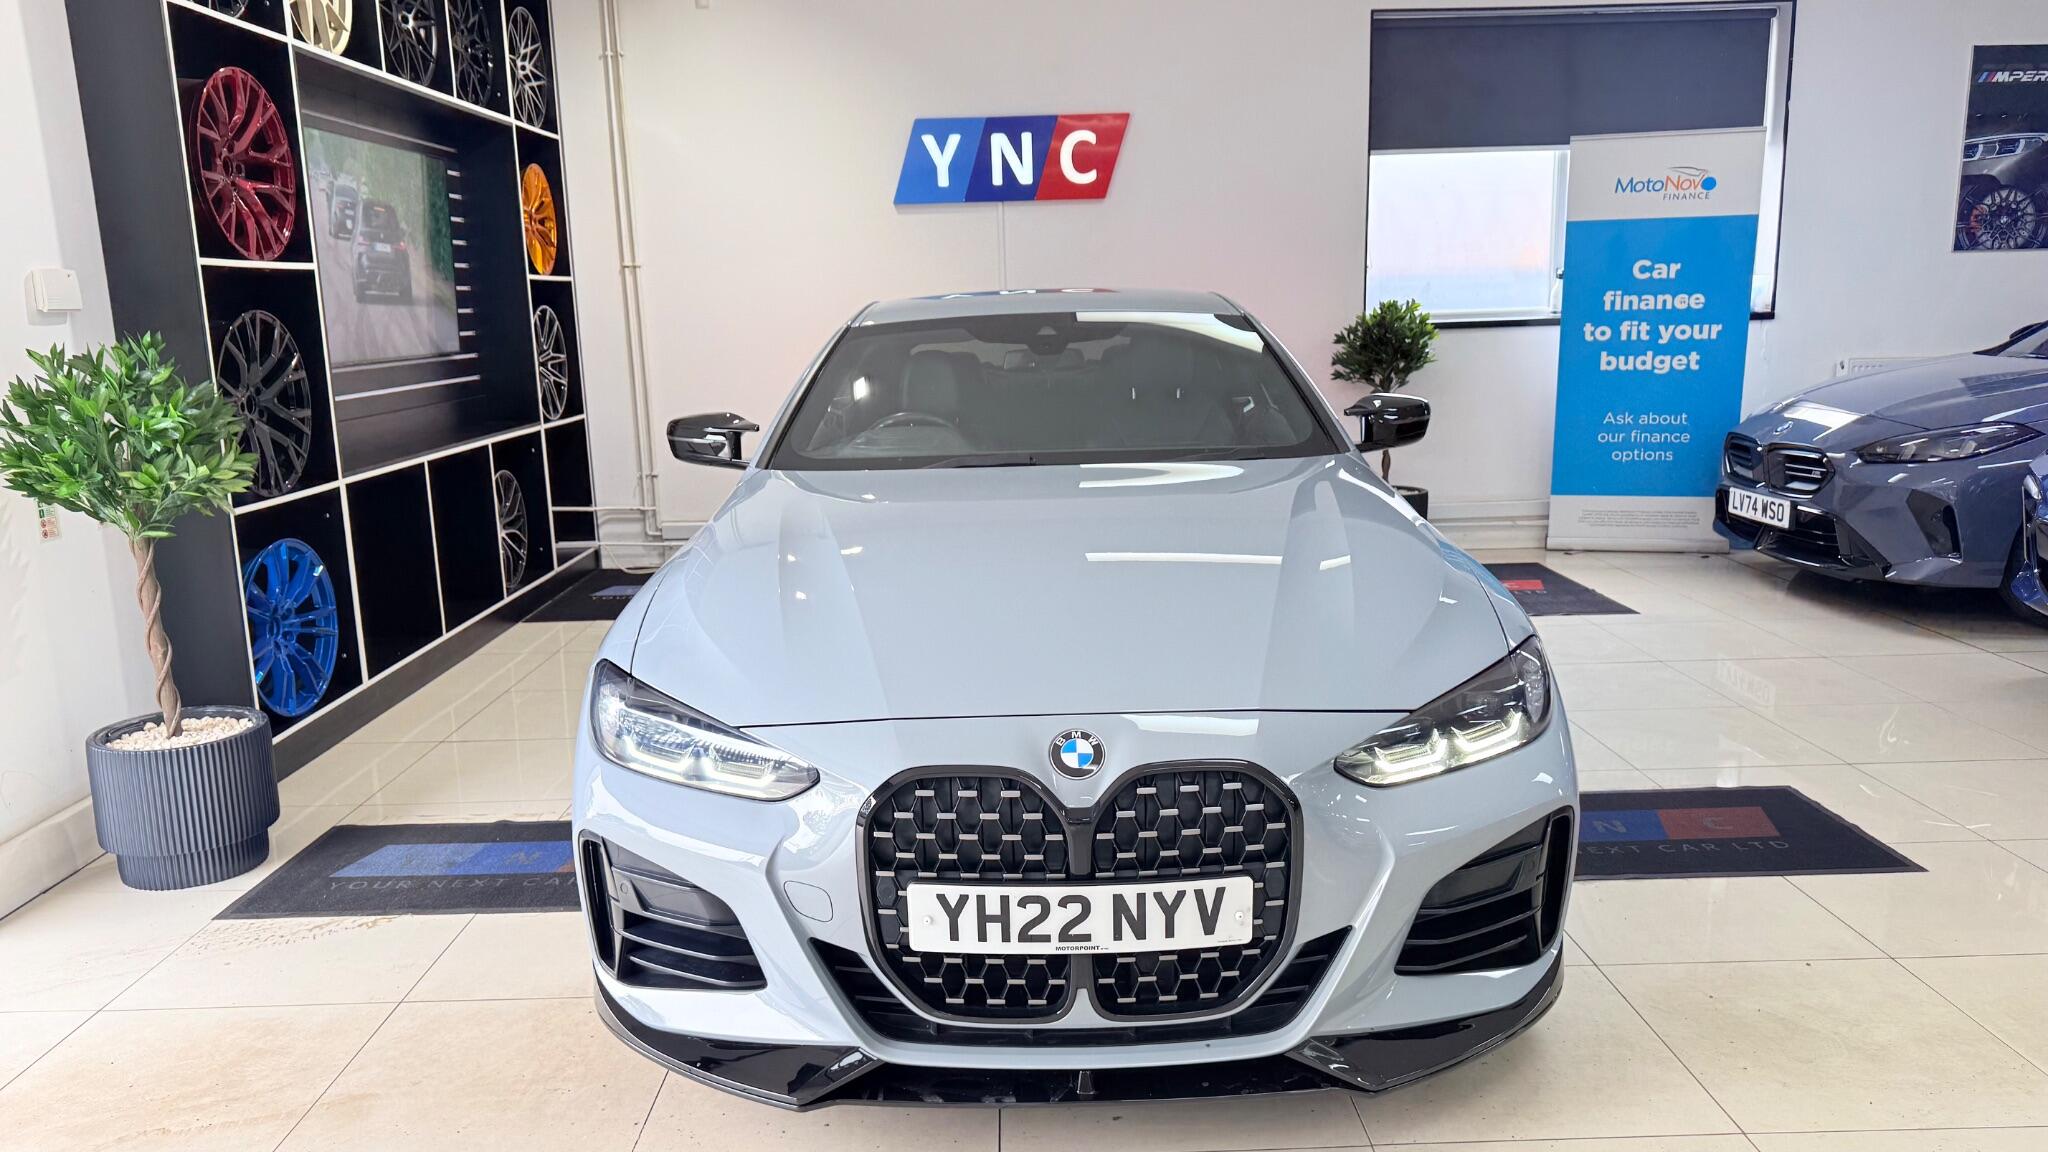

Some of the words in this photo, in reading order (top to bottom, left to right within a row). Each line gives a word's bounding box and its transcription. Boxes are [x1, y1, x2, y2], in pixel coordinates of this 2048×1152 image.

[920, 130, 1098, 188] YNC
[1662, 191, 1711, 201] FINANCE
[1632, 259, 1682, 280] Car
[1603, 290, 1706, 311] finance
[1583, 322, 1612, 342] to
[1620, 321, 1650, 341] fit
[1658, 323, 1723, 345] your
[1600, 351, 1700, 375] budget
[1603, 412, 1634, 425] Ask
[1639, 412, 1688, 425] about
[1597, 432, 1626, 443] our
[1631, 429, 1691, 443] finance
[1611, 448, 1674, 462] options
[1732, 491, 1759, 516] LV74
[1761, 498, 1785, 522] WSO
[1055, 731, 1099, 747] BMW
[1578, 845, 1641, 855] EXT
[1657, 842, 1721, 854] CAR
[1732, 840, 1790, 852] LTD
[329, 878, 412, 891] YOUR
[426, 877, 510, 890] NEXT
[935, 893, 1092, 943] YH22
[1112, 886, 1227, 942] NYV
